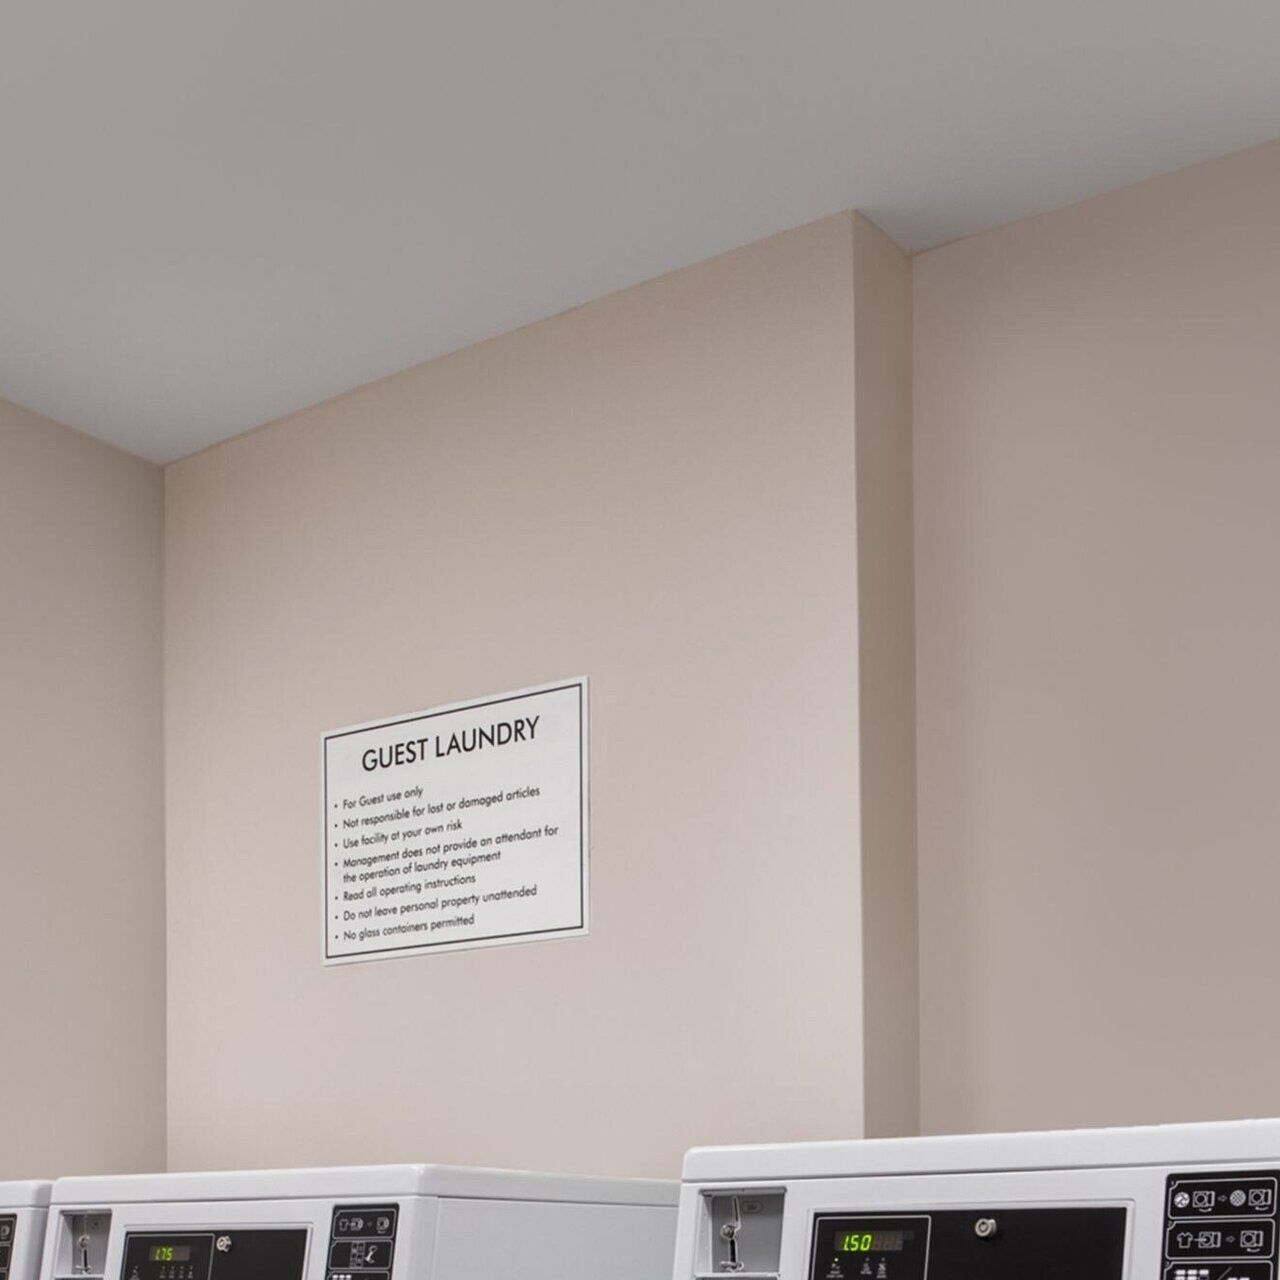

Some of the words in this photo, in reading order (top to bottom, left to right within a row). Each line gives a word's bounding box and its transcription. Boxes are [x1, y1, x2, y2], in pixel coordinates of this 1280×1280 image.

[362, 738, 428, 772] GUEST
[435, 715, 540, 758] LAUNDRY
[343, 799, 356, 809] For
[359, 794, 384, 806] Guest
[387, 792, 401, 801] use
[404, 786, 423, 798] only
[343, 819, 358, 828] Not
[361, 808, 410, 826] responsible
[412, 805, 425, 817] for
[428, 803, 443, 814] lost
[446, 803, 456, 811] or
[459, 791, 503, 808] damaged
[506, 786, 540, 801] articles
[343, 839, 359, 849] Use
[361, 833, 388, 845] facility
[391, 831, 400, 841] at
[402, 829, 422, 841] your
[425, 825, 444, 835] own
[446, 819, 462, 831] risk
[343, 851, 399, 868] Management
[402, 847, 423, 859] does
[425, 844, 440, 854] not
[443, 837, 477, 854] provide
[480, 837, 492, 847] an
[495, 828, 542, 844] attendant
[544, 824, 559, 836] for
[343, 873, 356, 883] the
[359, 866, 400, 882] operation
[402, 862, 412, 874] of
[414, 858, 448, 872] laundry
[451, 851, 501, 868] equipment
[343, 888, 364, 901] Read
[366, 886, 377, 898] all
[379, 882, 422, 897] operating
[424, 874, 476, 889] instructions
[343, 910, 356, 921] Do
[358, 908, 372, 919] not
[375, 906, 398, 917] leave
[400, 898, 439, 916] personal
[441, 894, 480, 910] property
[482, 883, 537, 902] unattended
[343, 931, 356, 940] No
[359, 927, 380, 941] glass
[382, 922, 428, 936] containers
[430, 913, 475, 931] permitted
